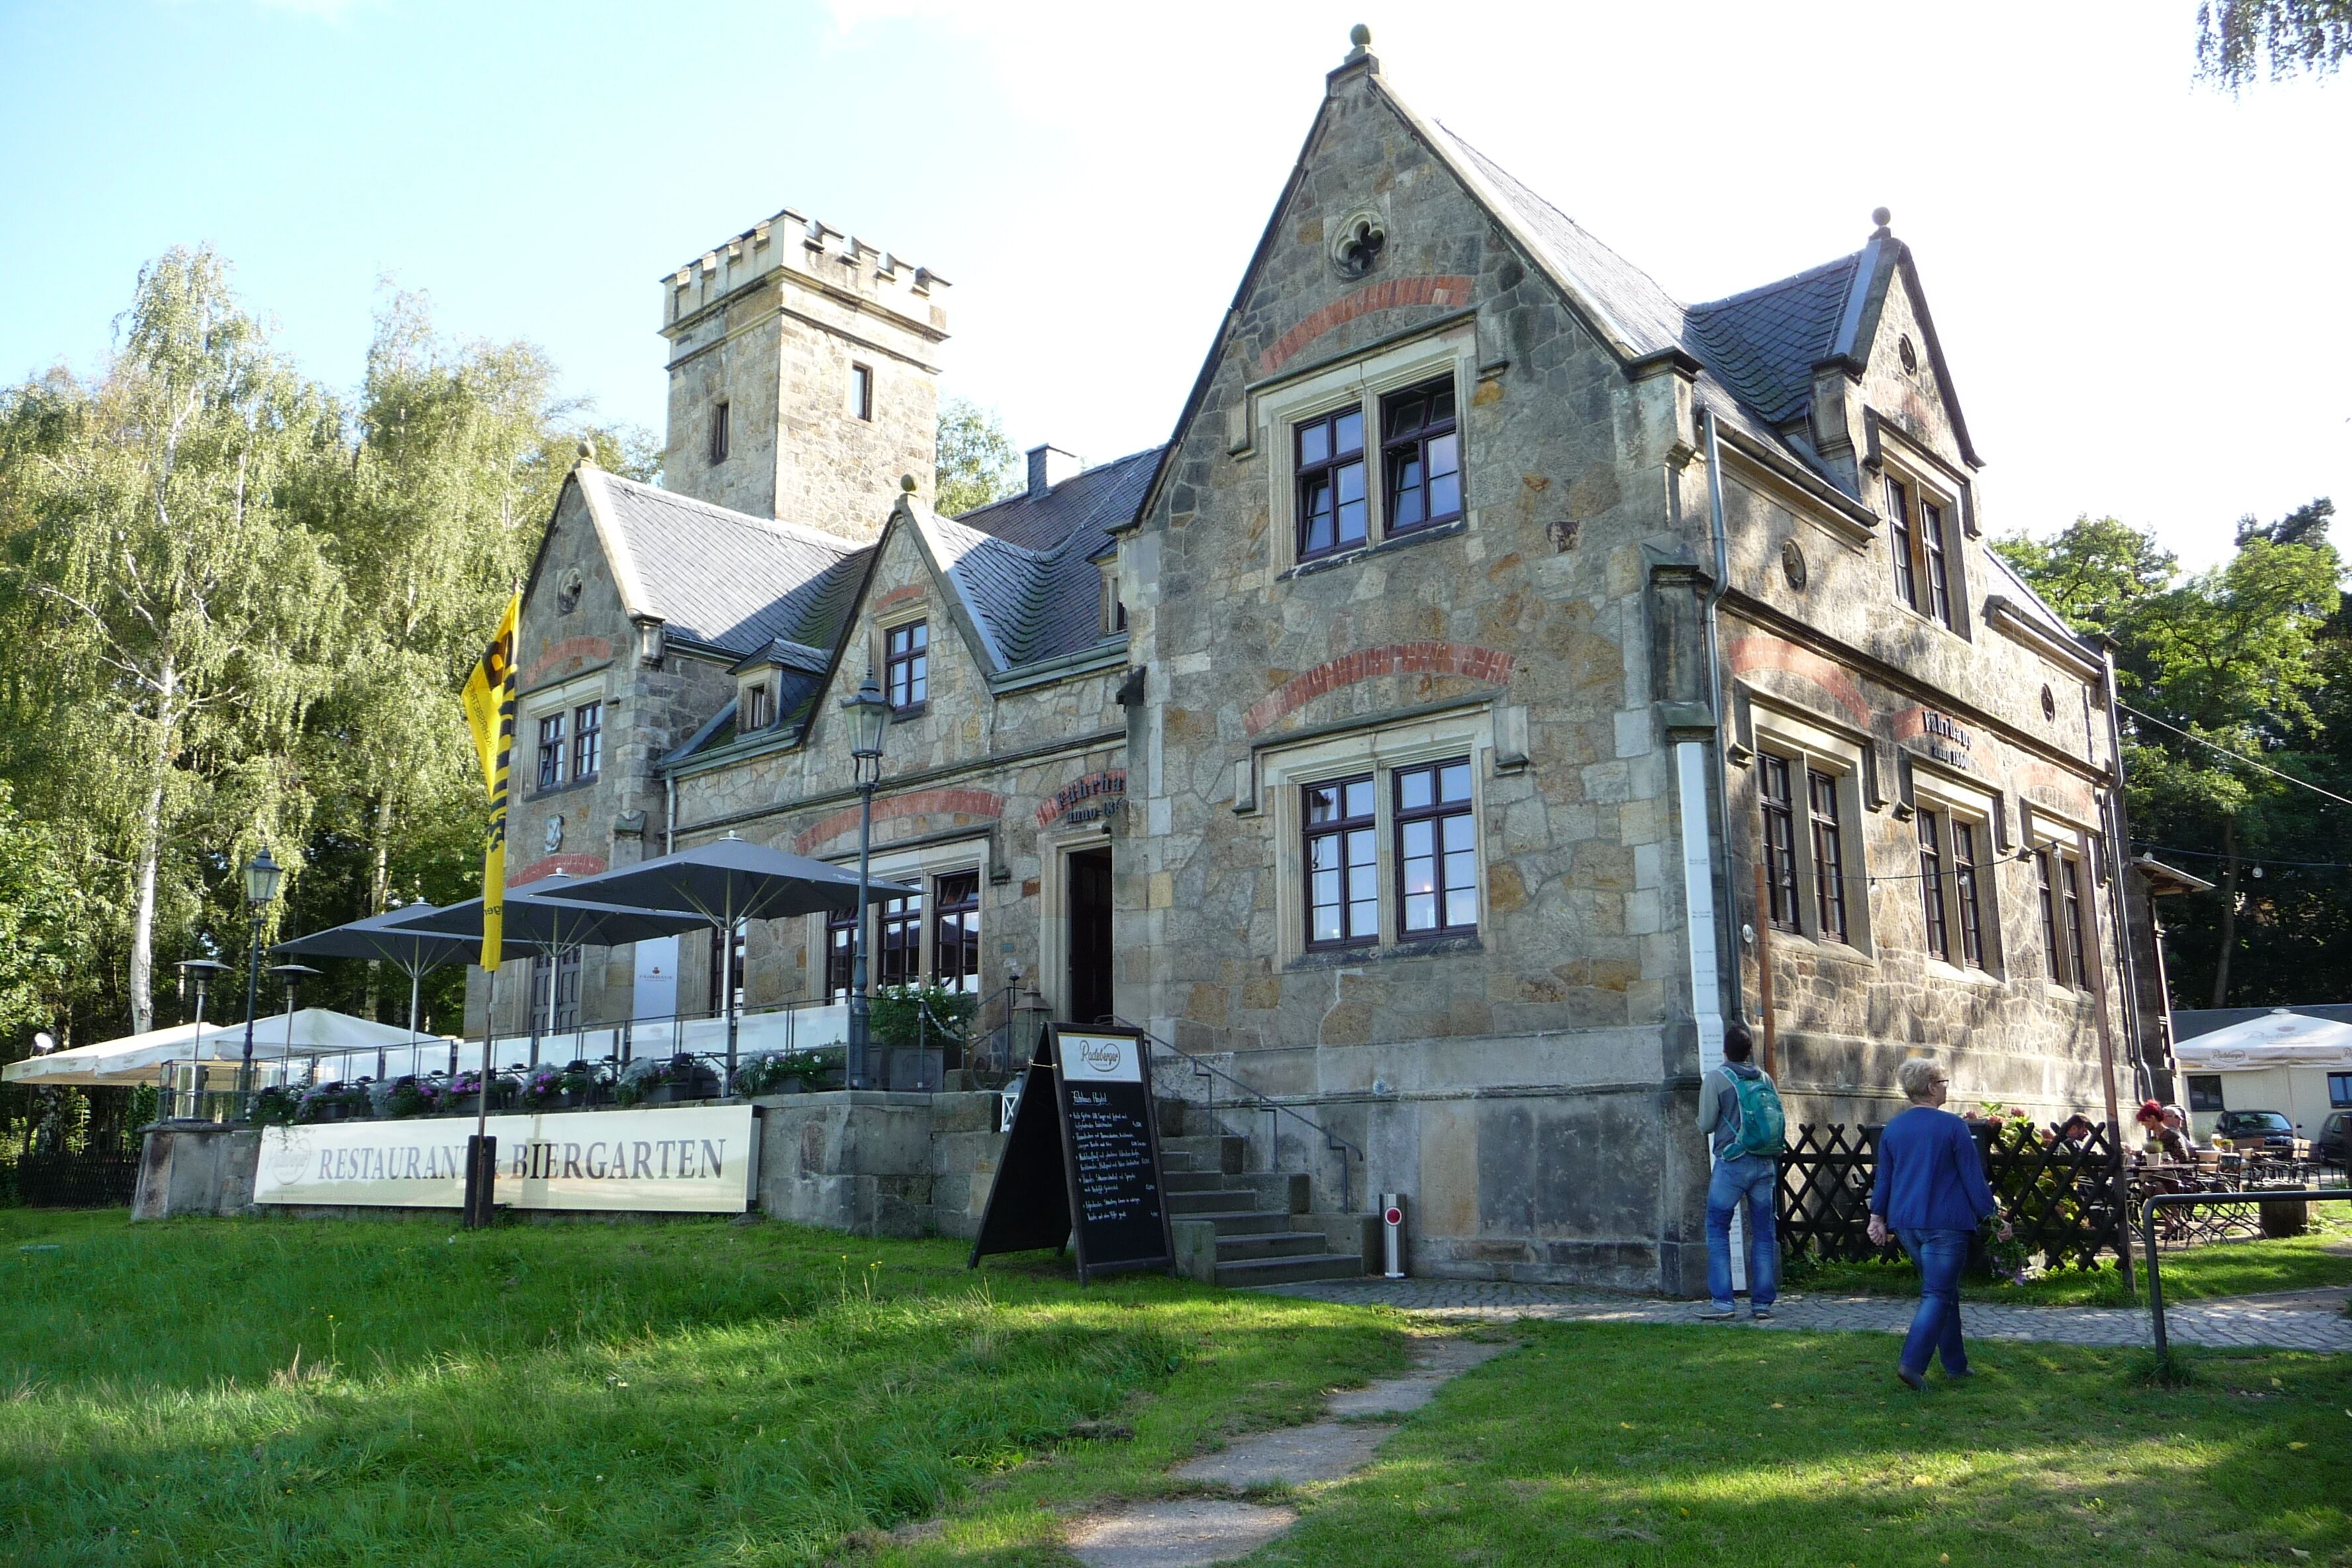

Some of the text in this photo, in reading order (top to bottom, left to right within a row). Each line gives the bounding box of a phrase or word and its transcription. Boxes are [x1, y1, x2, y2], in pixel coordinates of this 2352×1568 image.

[1953, 750, 1970, 768] 1860
[1080, 1040, 1120, 1069] Radeberger
[510, 1139, 726, 1179] BIERGARTEN
